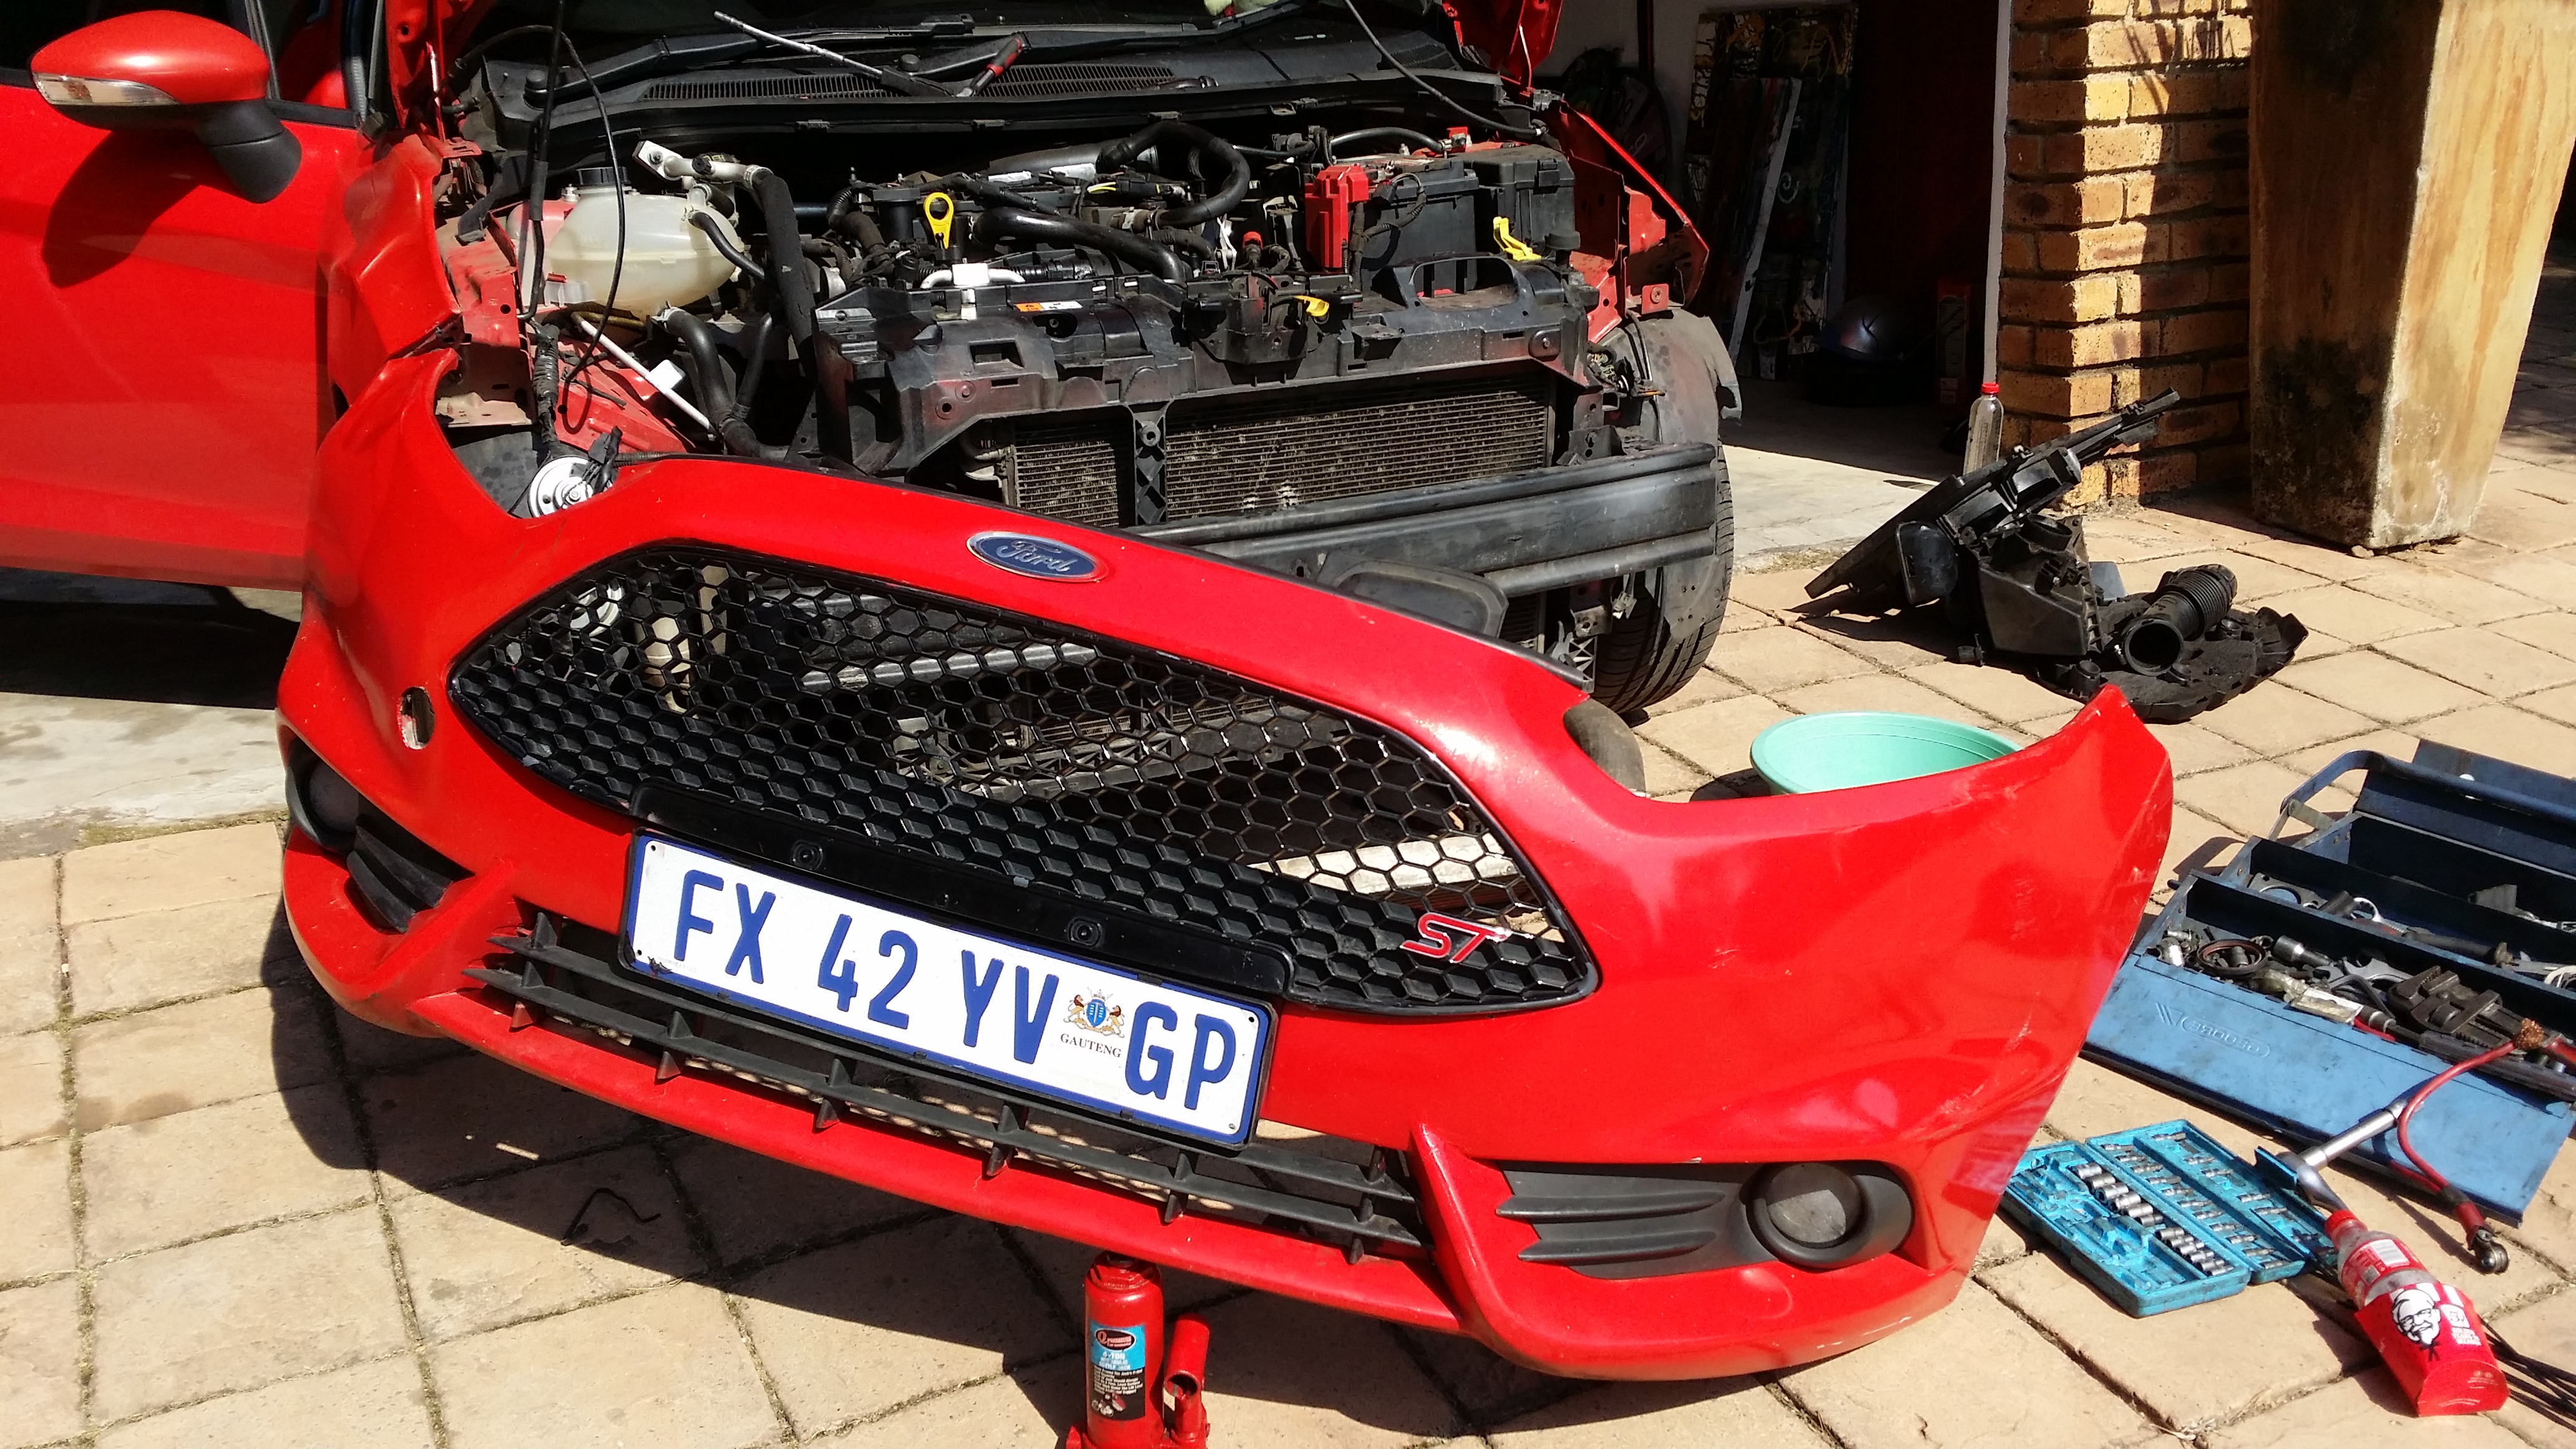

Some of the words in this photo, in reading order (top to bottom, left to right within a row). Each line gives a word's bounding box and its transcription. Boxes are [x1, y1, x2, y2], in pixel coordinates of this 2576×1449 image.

[996, 540, 1078, 572] Ford
[1399, 911, 1513, 964] ST
[675, 870, 775, 982] FX
[819, 915, 917, 1028] 42
[963, 951, 1058, 1063] YV
[1126, 1002, 1236, 1108] GP
[1060, 1033, 1122, 1058] GAUTENG
[2190, 1020, 2260, 1052] GEDORE
